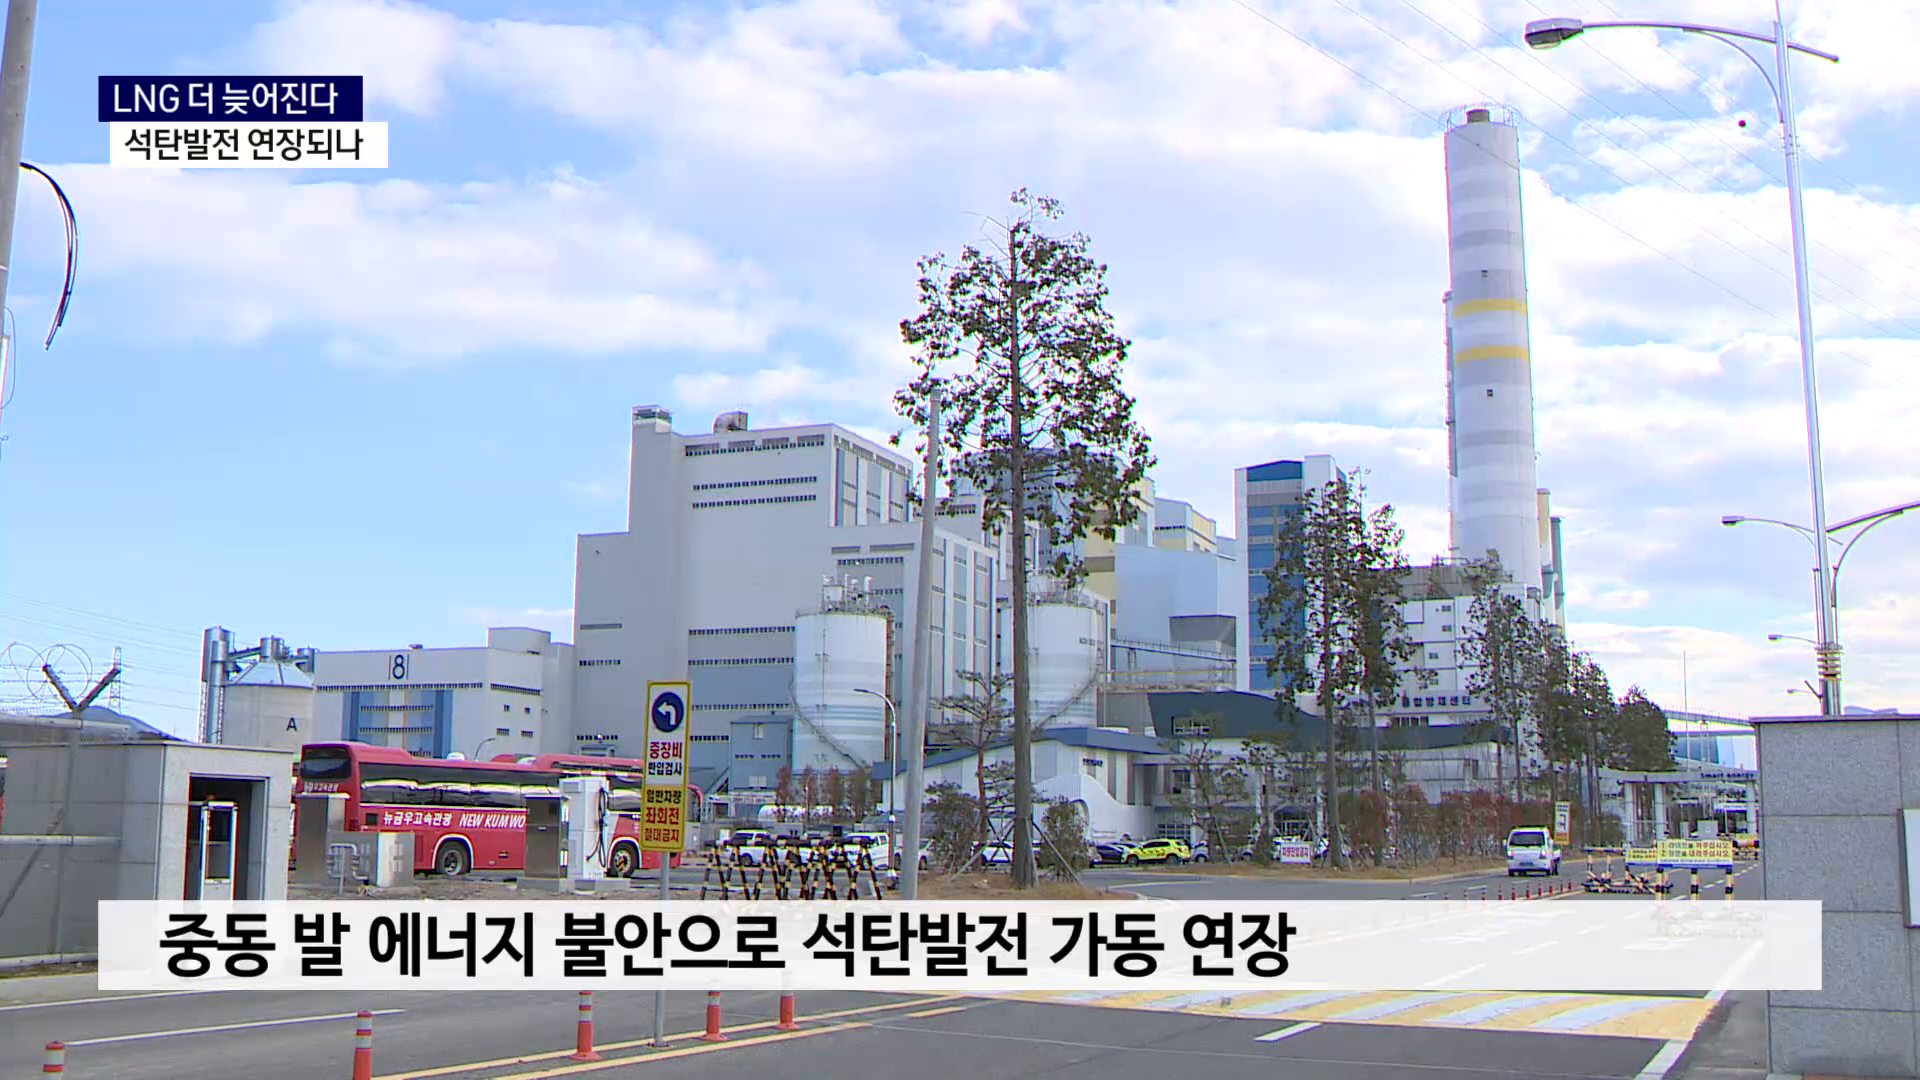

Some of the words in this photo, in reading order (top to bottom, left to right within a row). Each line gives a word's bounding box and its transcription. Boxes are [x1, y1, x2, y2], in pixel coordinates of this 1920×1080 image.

[392, 654, 405, 679] 8
[287, 717, 297, 731] A
[649, 741, 683, 760] 중장비
[648, 761, 682, 776] 반입검사
[646, 789, 682, 804] 일반차량
[459, 813, 483, 828] NEW
[645, 807, 680, 825] 좌회전
[644, 828, 680, 842] 절대금지
